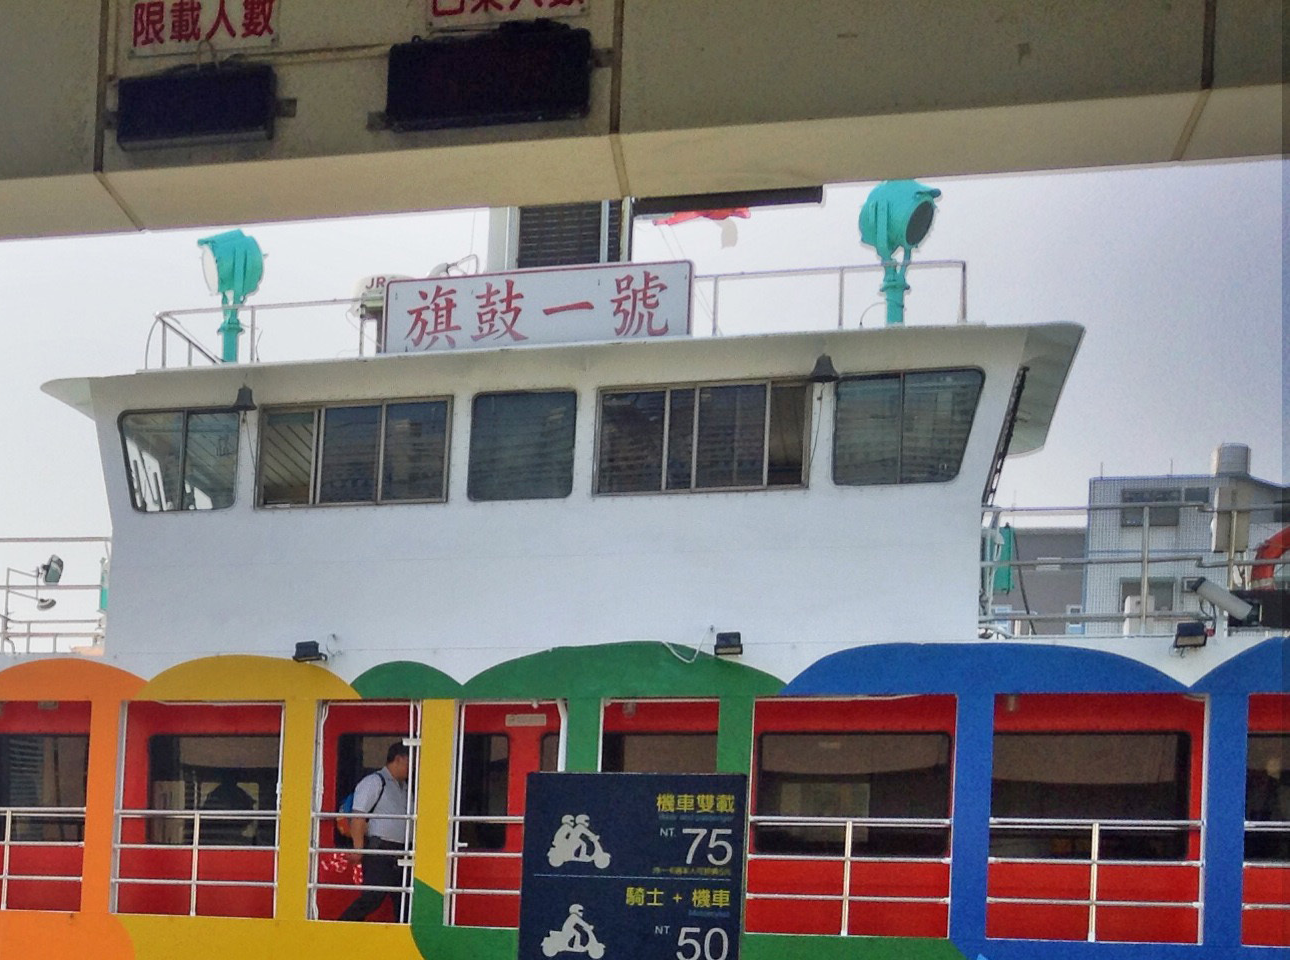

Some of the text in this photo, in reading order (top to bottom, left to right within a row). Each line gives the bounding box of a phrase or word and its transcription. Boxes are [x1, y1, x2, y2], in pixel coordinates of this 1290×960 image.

[132, 0, 274, 47] 限載人數
[404, 270, 669, 350] 旗鼓一號
[656, 793, 735, 813] 機車雙載
[682, 828, 733, 866] 75
[626, 887, 664, 906] 騎士
[692, 888, 730, 908] 機車
